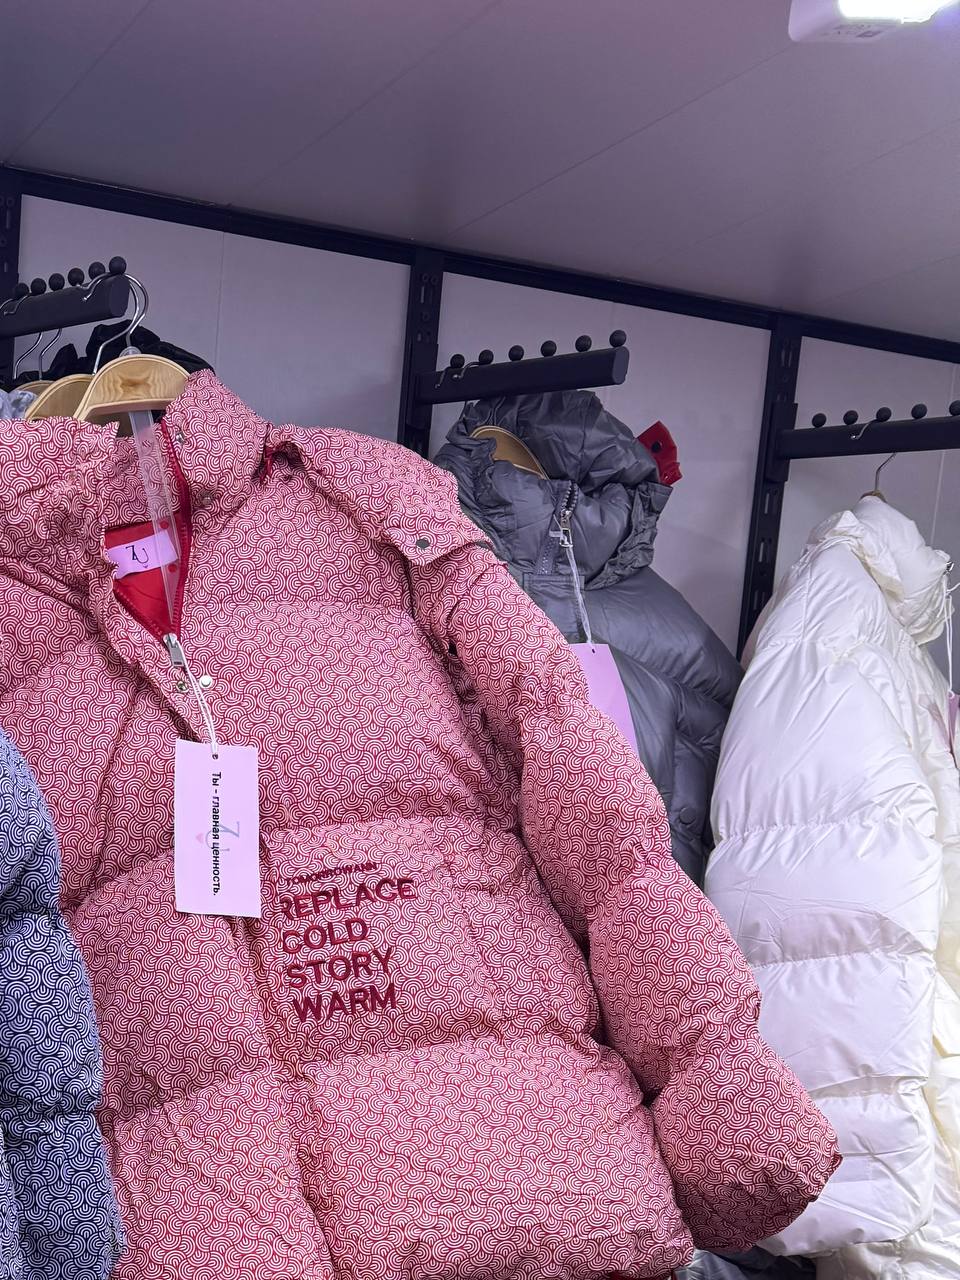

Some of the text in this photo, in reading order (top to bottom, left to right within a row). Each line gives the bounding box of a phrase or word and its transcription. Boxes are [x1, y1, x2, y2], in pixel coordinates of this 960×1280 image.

[211, 771, 222, 786] Ты
[211, 796, 220, 840] главная
[210, 842, 221, 896] ценность.
[280, 877, 418, 920] REPLACE
[282, 917, 369, 954] COLD
[287, 947, 392, 988] STORY
[292, 982, 397, 1023] WARM
